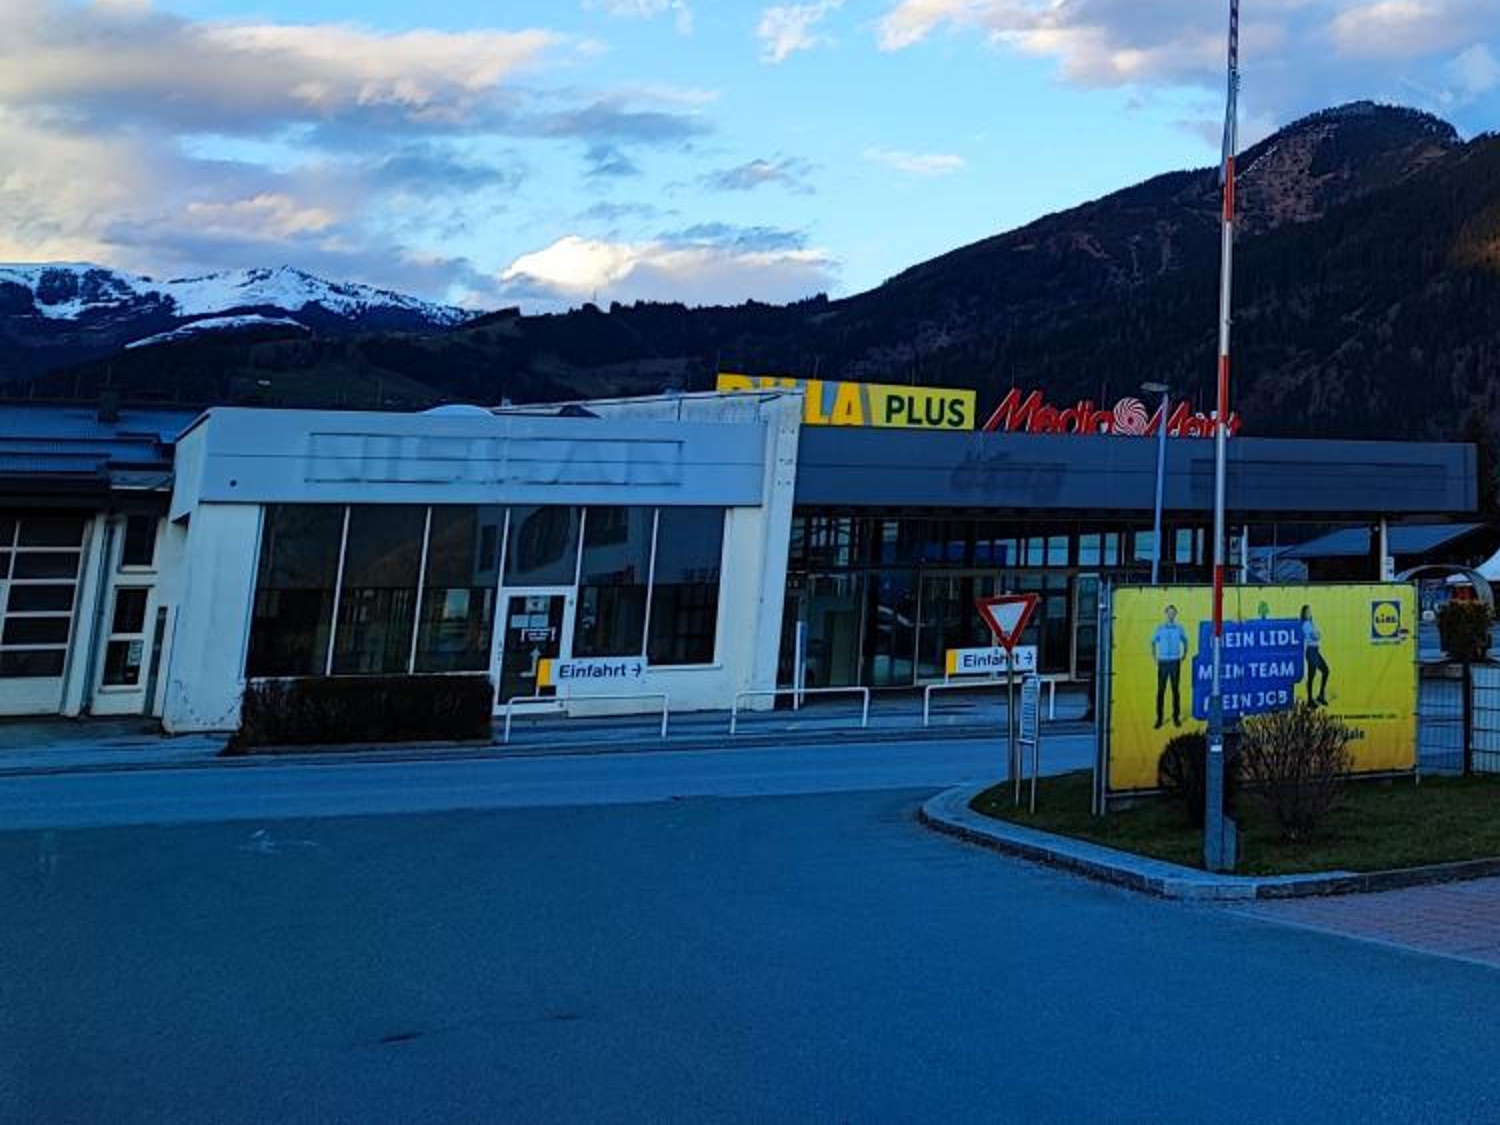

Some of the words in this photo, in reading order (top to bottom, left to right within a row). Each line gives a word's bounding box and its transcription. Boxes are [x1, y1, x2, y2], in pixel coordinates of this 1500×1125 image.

[885, 394, 965, 426] PLUS
[982, 387, 1114, 432] Media
[1259, 629, 1300, 646] LIDL
[963, 653, 1020, 668] Einfaht
[559, 663, 627, 679] Einfahrt
[1198, 663, 1245, 681] MIN
[1248, 661, 1295, 678] TEAM
[1257, 690, 1288, 707] JOB
